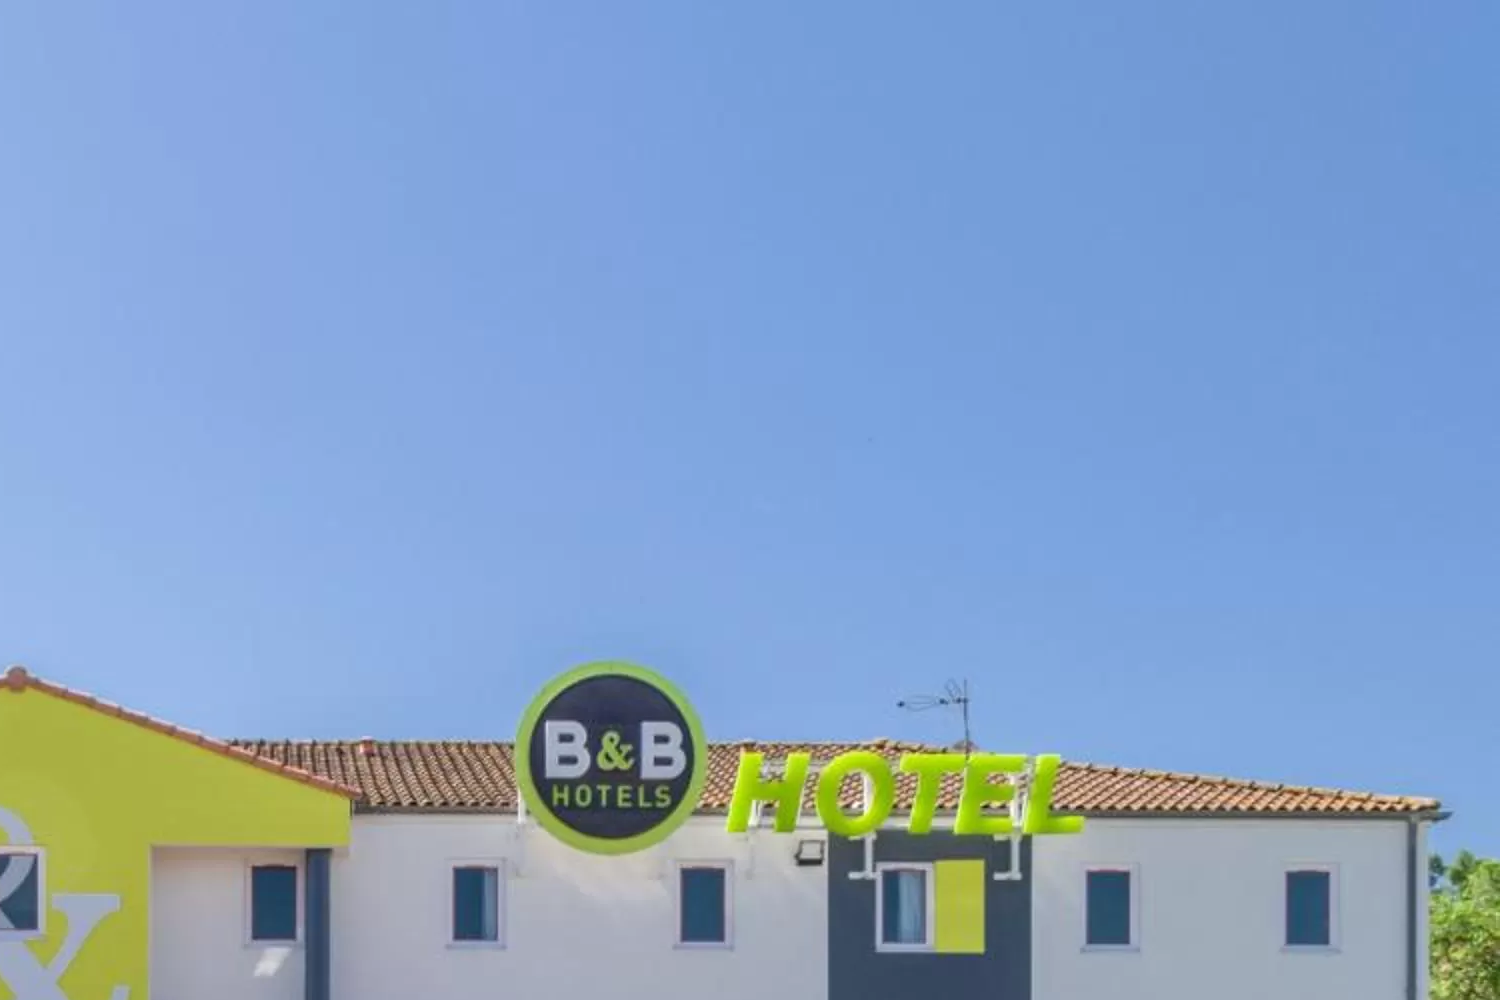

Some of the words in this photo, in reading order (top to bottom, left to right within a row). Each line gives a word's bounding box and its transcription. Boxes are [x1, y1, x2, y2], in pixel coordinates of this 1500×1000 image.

[545, 720, 688, 780] B&B
[552, 784, 672, 809] HOTELS
[726, 751, 1085, 835] HOTEL
